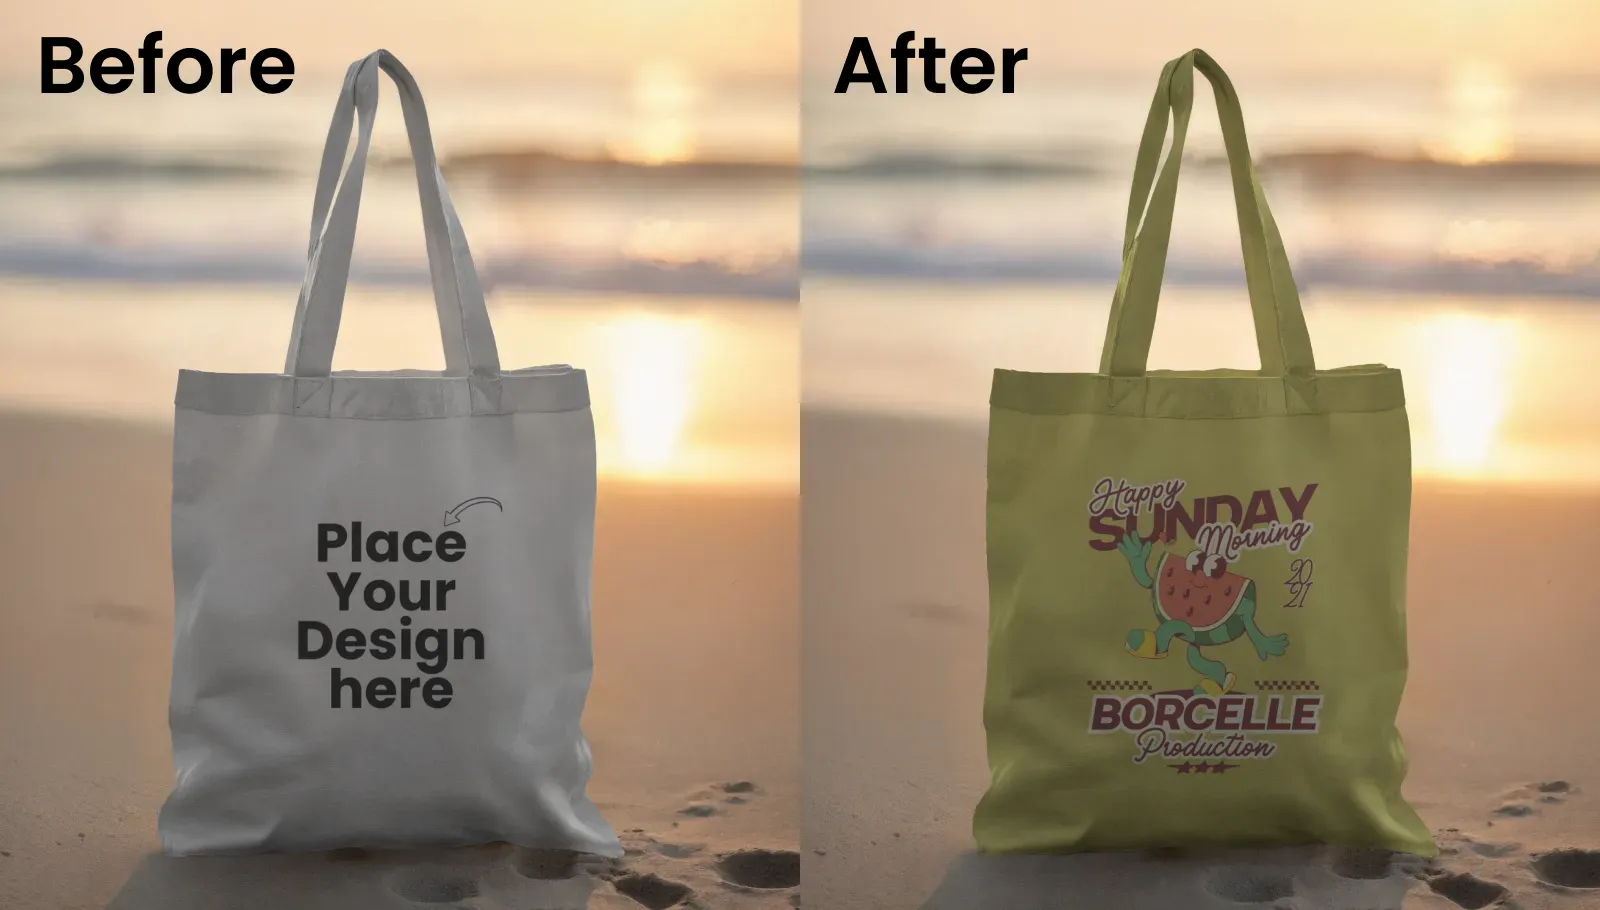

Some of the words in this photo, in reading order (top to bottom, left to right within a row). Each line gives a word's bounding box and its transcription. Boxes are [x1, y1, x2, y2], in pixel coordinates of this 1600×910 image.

[1089, 478, 1184, 515] Happy
[1088, 483, 1319, 552] SUNDAY
[317, 521, 467, 563] Place
[1197, 519, 1311, 560] Morning
[326, 571, 456, 611] Your
[1284, 558, 1314, 585] 20
[1282, 582, 1313, 608] 21
[297, 615, 485, 675] Design
[330, 667, 454, 709] here
[1091, 697, 1321, 731] BORCELLE
[1133, 728, 1276, 762] Production
